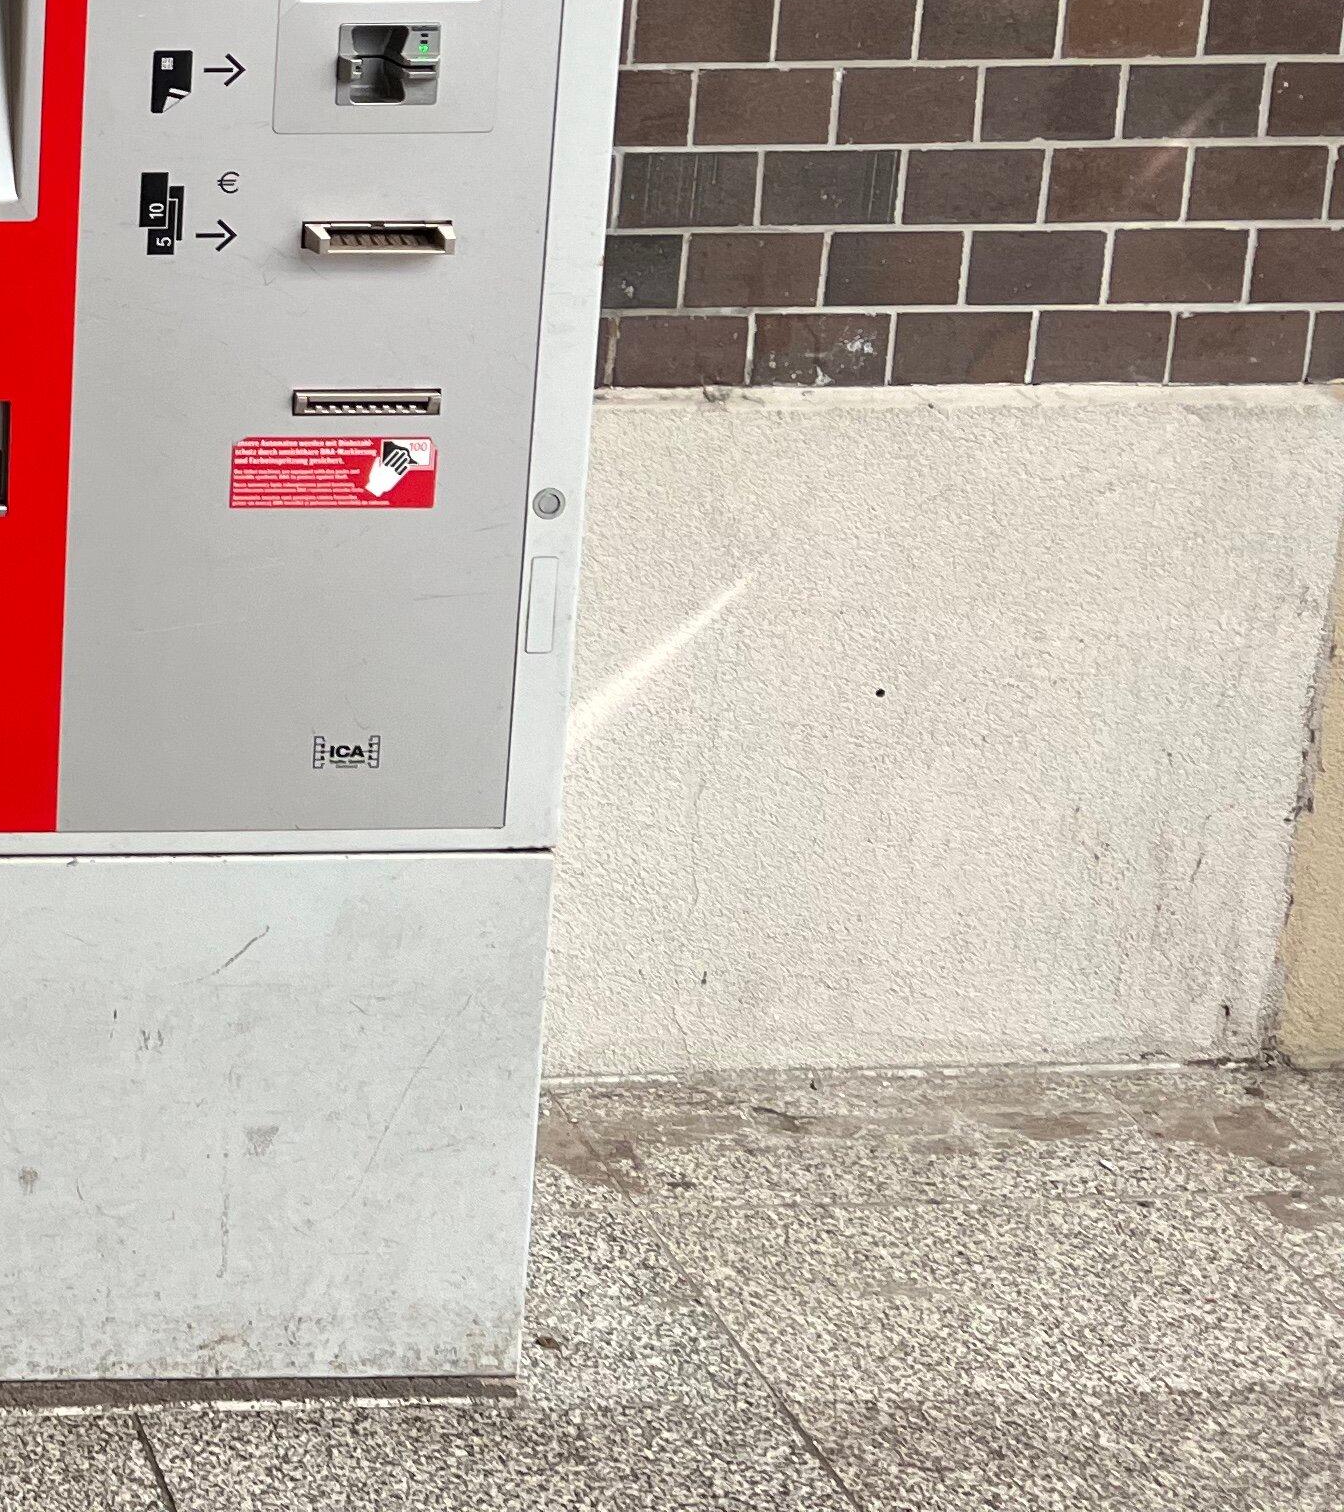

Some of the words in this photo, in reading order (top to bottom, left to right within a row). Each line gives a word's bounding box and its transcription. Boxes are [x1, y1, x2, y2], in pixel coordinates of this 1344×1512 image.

[217, 171, 240, 194] €
[148, 202, 165, 220] 10
[156, 236, 172, 247] 5
[409, 441, 428, 452] 100
[329, 744, 365, 758] ICA
